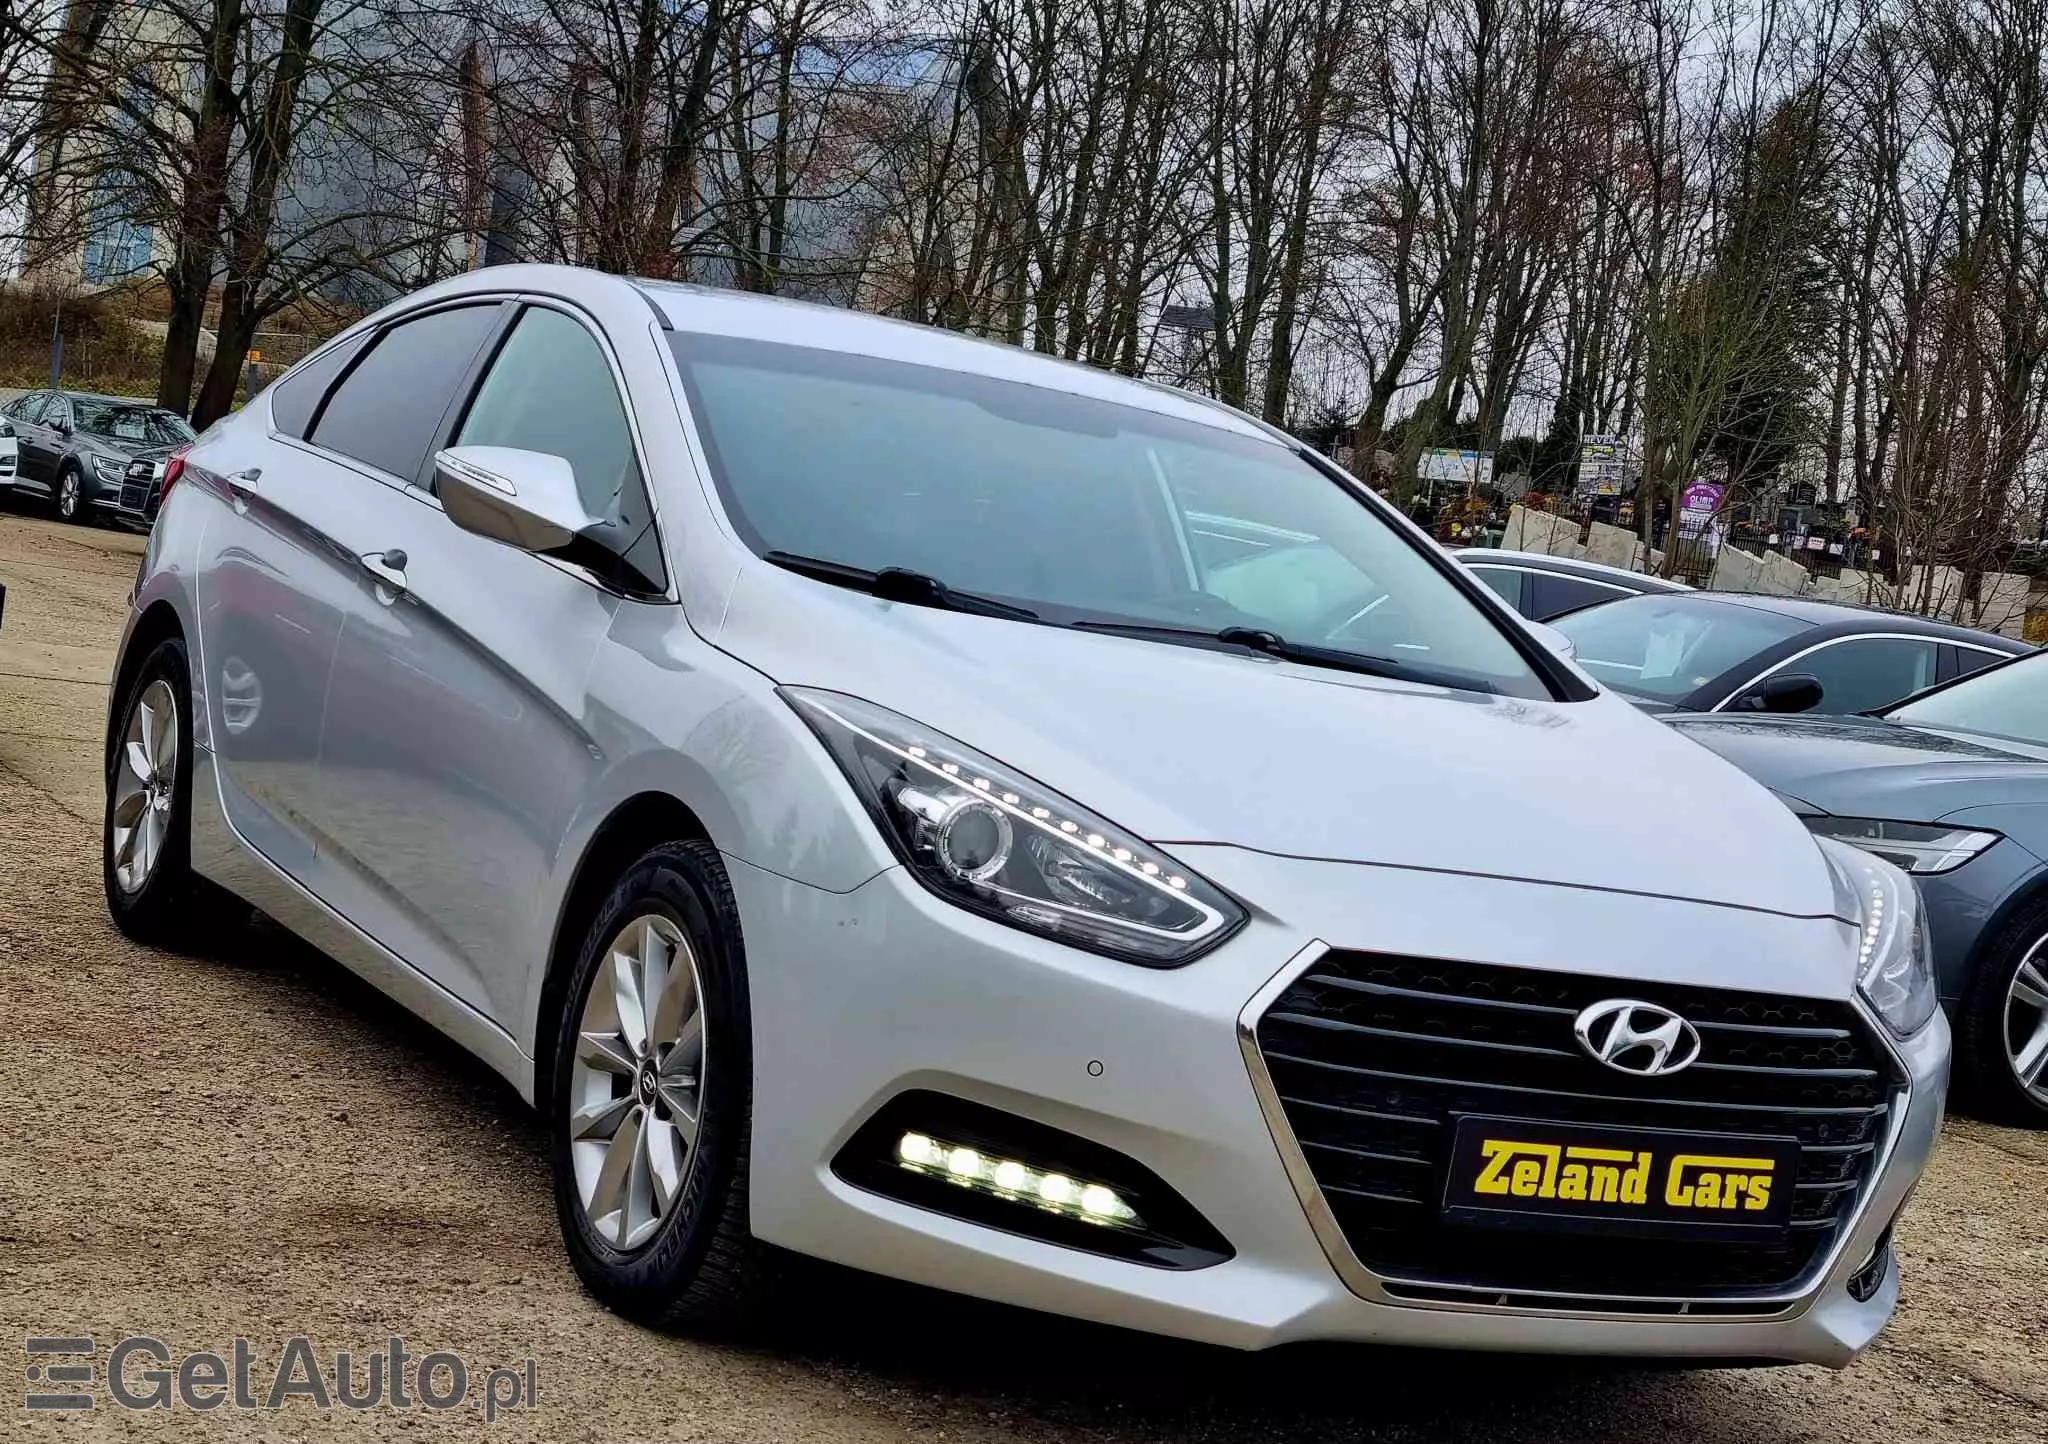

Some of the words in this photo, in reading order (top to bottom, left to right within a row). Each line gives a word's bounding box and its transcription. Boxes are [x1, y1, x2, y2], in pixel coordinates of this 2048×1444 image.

[1690, 495, 1713, 508] OLIMP
[1474, 1139, 1653, 1204] Zeland
[1665, 1154, 1775, 1211] Cars
